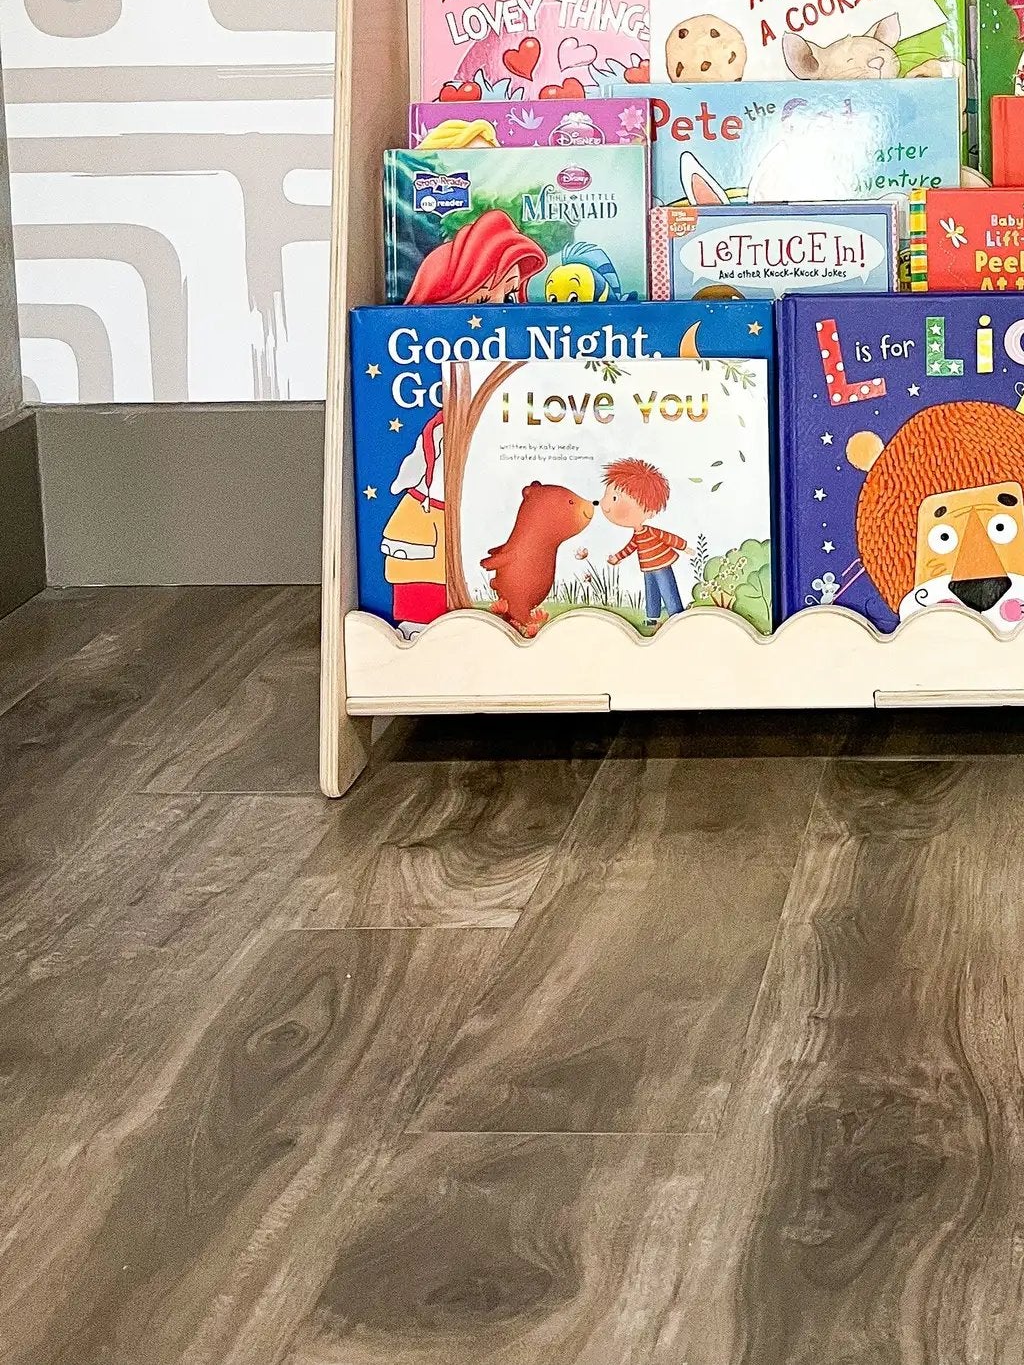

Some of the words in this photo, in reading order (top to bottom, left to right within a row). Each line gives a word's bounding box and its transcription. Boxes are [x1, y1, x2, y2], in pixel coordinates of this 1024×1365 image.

[760, 19, 777, 46] A
[650, 97, 743, 142] Pete
[744, 101, 776, 121] the
[870, 142, 928, 162] aster
[523, 184, 618, 224] MERMAID
[581, 193, 616, 201] LITTLE
[387, 326, 506, 365] Good
[816, 319, 886, 406] L
[855, 342, 872, 362] is
[880, 335, 915, 360] for
[502, 392, 509, 423] I
